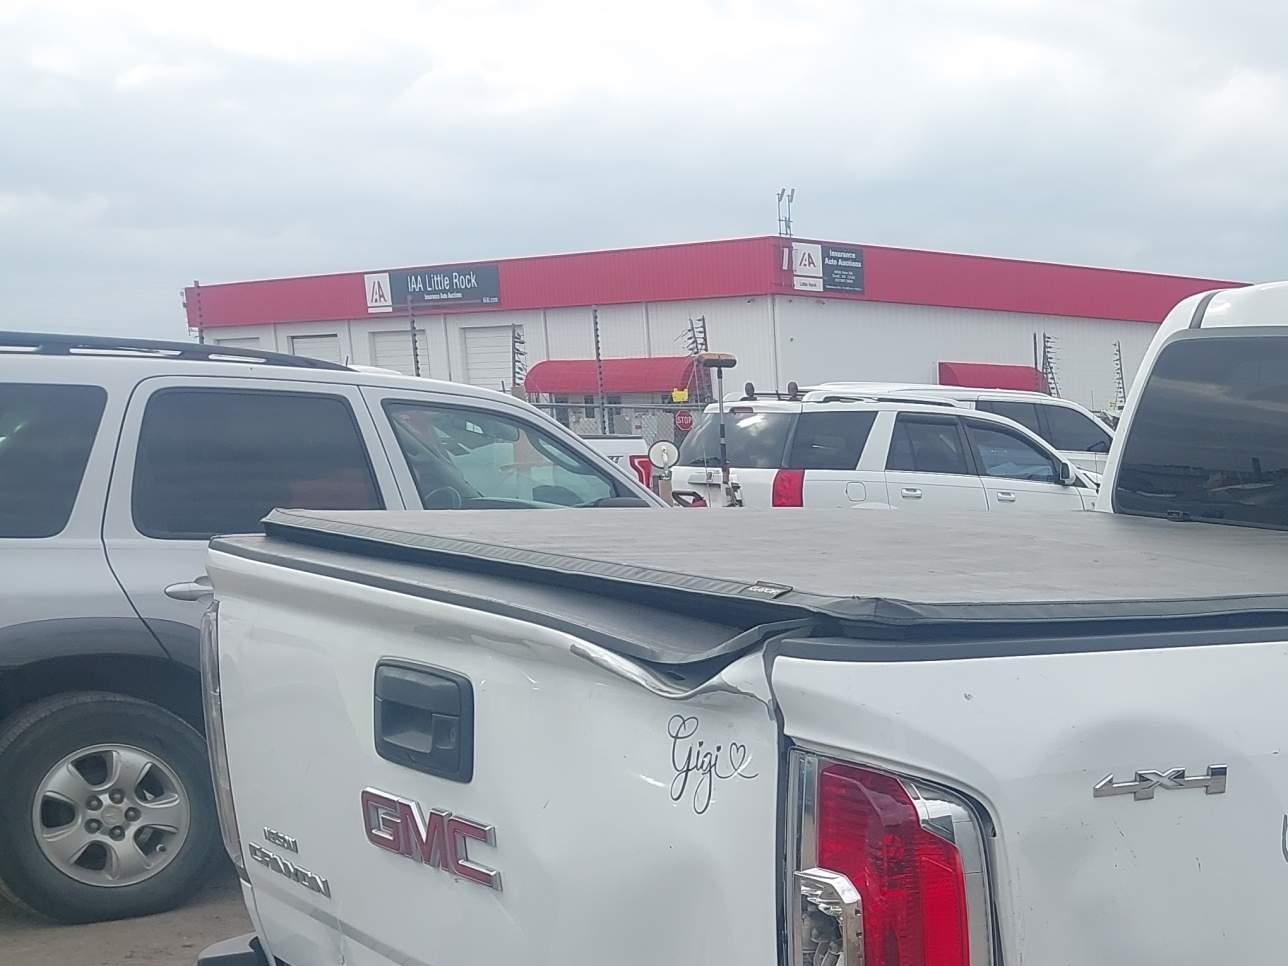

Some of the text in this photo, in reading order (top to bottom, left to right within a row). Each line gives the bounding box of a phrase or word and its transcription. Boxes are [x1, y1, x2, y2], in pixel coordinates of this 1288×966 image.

[407, 271, 478, 292] IAA Little Rock
[677, 415, 692, 424] STOP
[668, 714, 743, 815] Gigi
[361, 786, 504, 893] GMC
